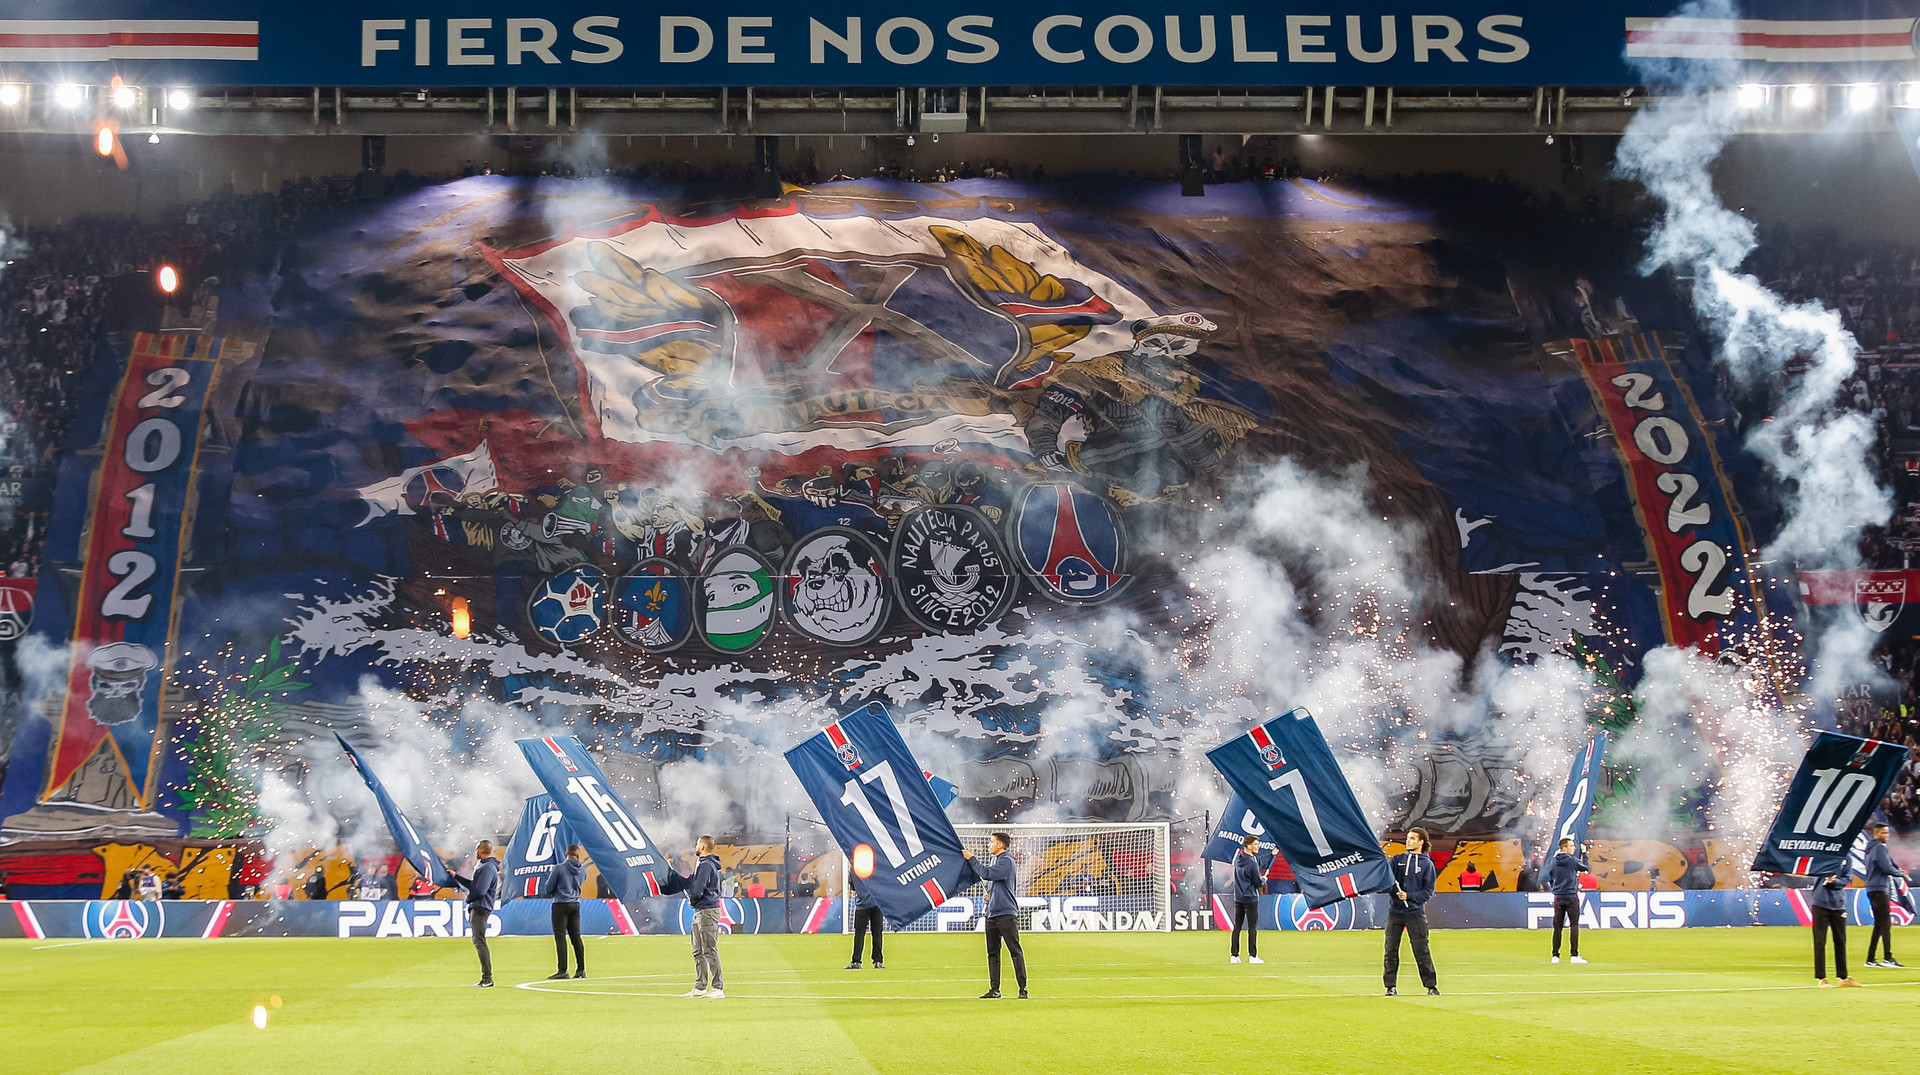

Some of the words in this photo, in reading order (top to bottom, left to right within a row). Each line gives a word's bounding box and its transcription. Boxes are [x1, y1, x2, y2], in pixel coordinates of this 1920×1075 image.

[361, 15, 624, 66] FIERS
[659, 15, 775, 64] DE
[810, 14, 1000, 65] NOS
[1032, 13, 1530, 64] COULEURS
[1048, 390, 1075, 408] 2012
[101, 367, 191, 620] 2012
[1611, 372, 1735, 619] 2022
[837, 517, 851, 526] 12
[901, 508, 957, 568] NAUTECIA
[960, 520, 999, 567] PARIS
[910, 584, 962, 626] SINCE
[962, 585, 1000, 626] 2012
[565, 775, 647, 853] 15
[840, 759, 925, 869] 17
[1268, 768, 1334, 858] 7
[1558, 777, 1589, 843] 2
[1792, 767, 1877, 838] 10
[525, 810, 563, 863] 6
[1217, 830, 1276, 850] MARQHOS
[1778, 839, 1826, 851] NEYMAR
[1825, 842, 1842, 852] JR
[514, 864, 555, 876] VERRATT
[625, 854, 655, 868] DANILO
[896, 854, 942, 886] VITINHA
[1316, 851, 1365, 875] MBAPPÉ
[338, 900, 502, 938] PARIS
